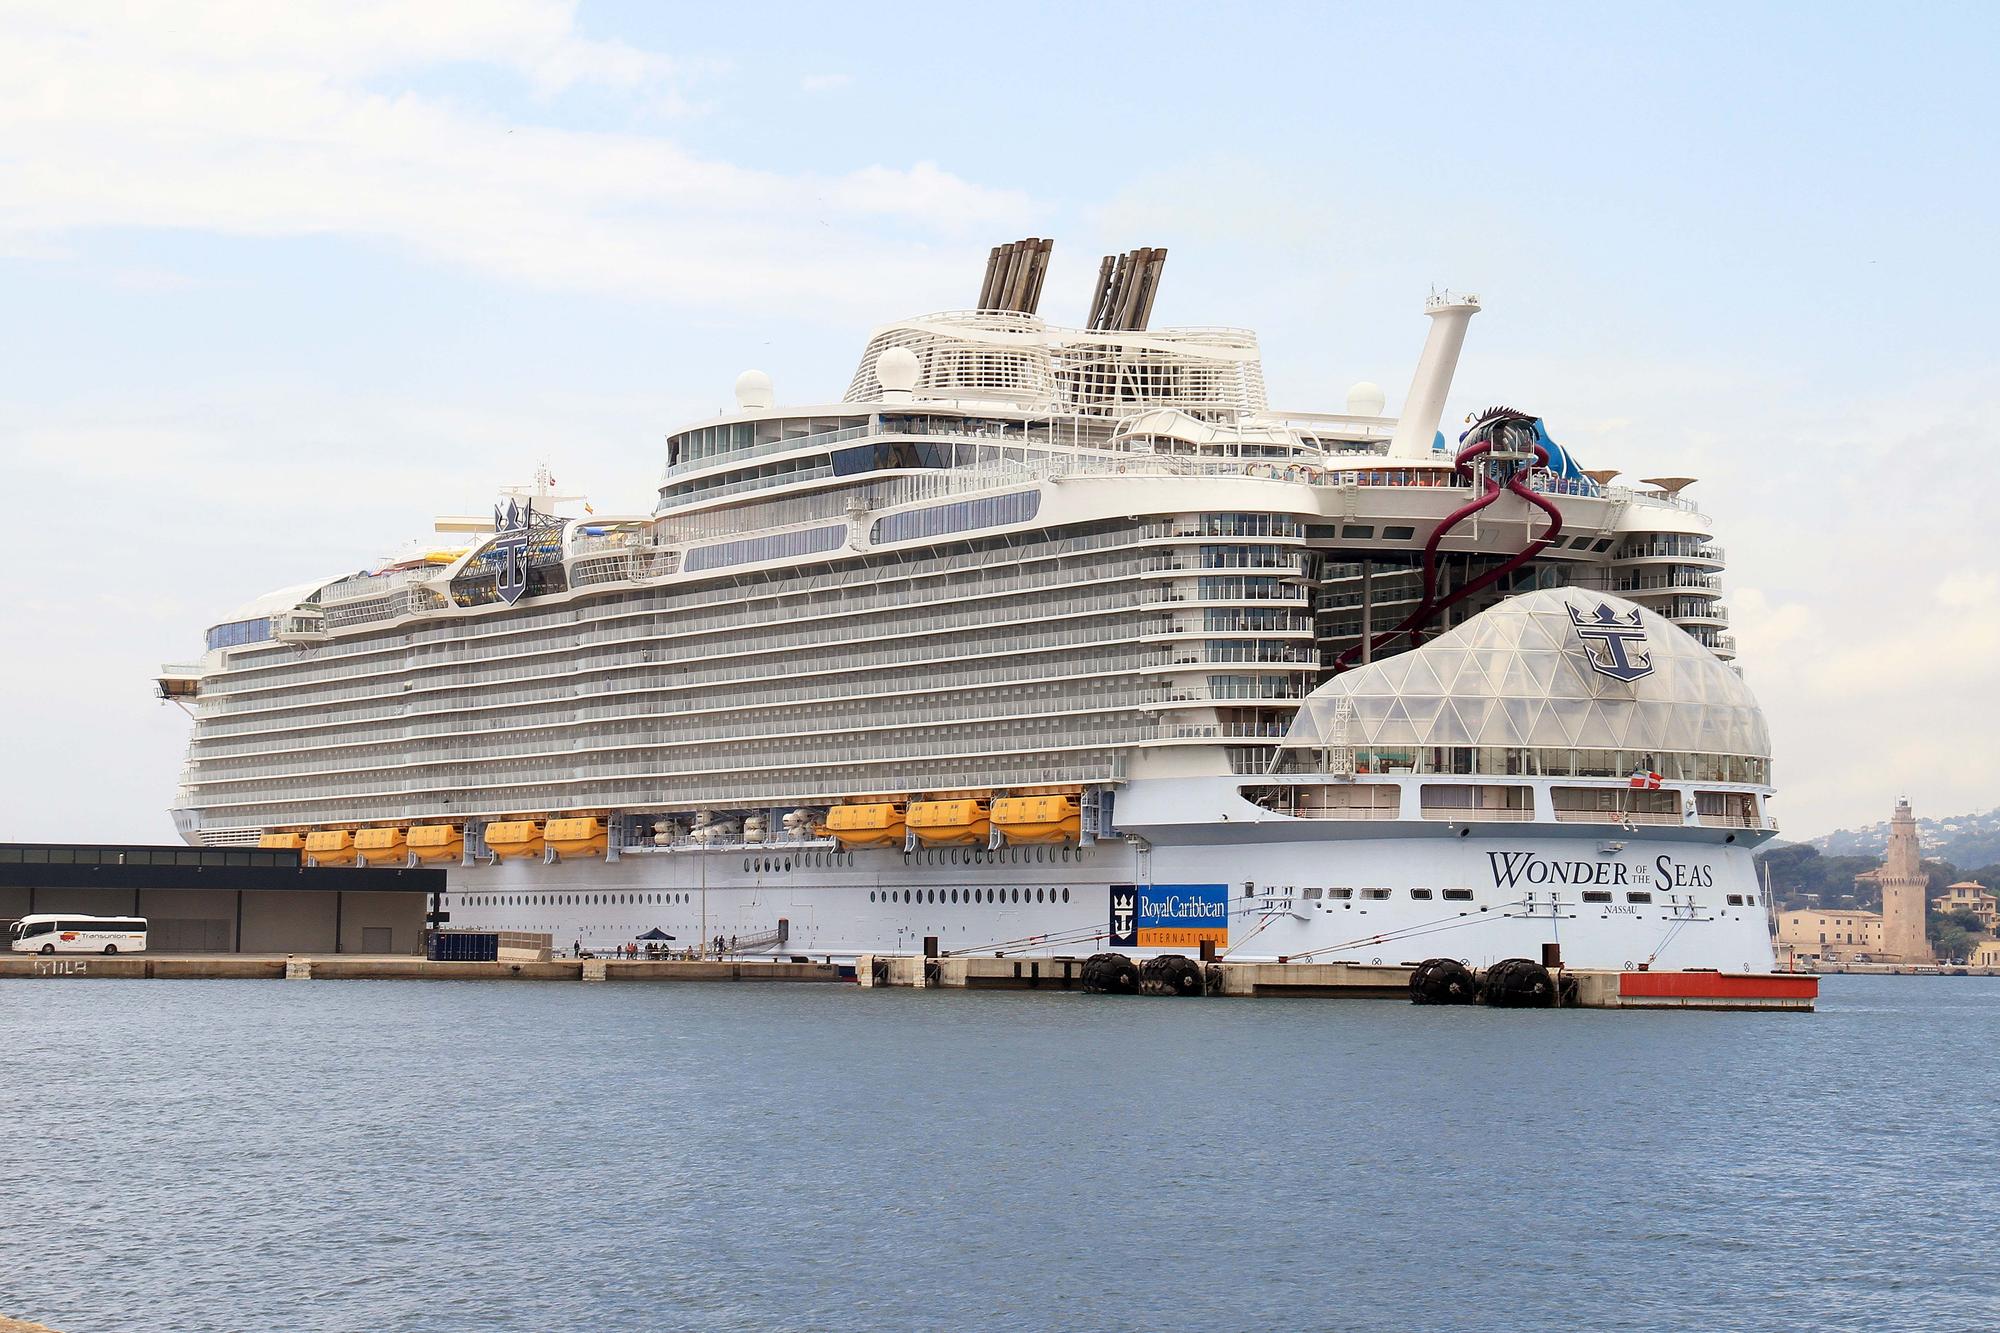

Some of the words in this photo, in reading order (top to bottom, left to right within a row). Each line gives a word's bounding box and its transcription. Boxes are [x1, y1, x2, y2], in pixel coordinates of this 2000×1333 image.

[1486, 851, 1628, 888] WONDER
[1635, 865, 1647, 874] OF
[1655, 855, 1713, 891] SEAS
[1632, 875, 1650, 884] THE
[1604, 905, 1638, 914] NASSAU
